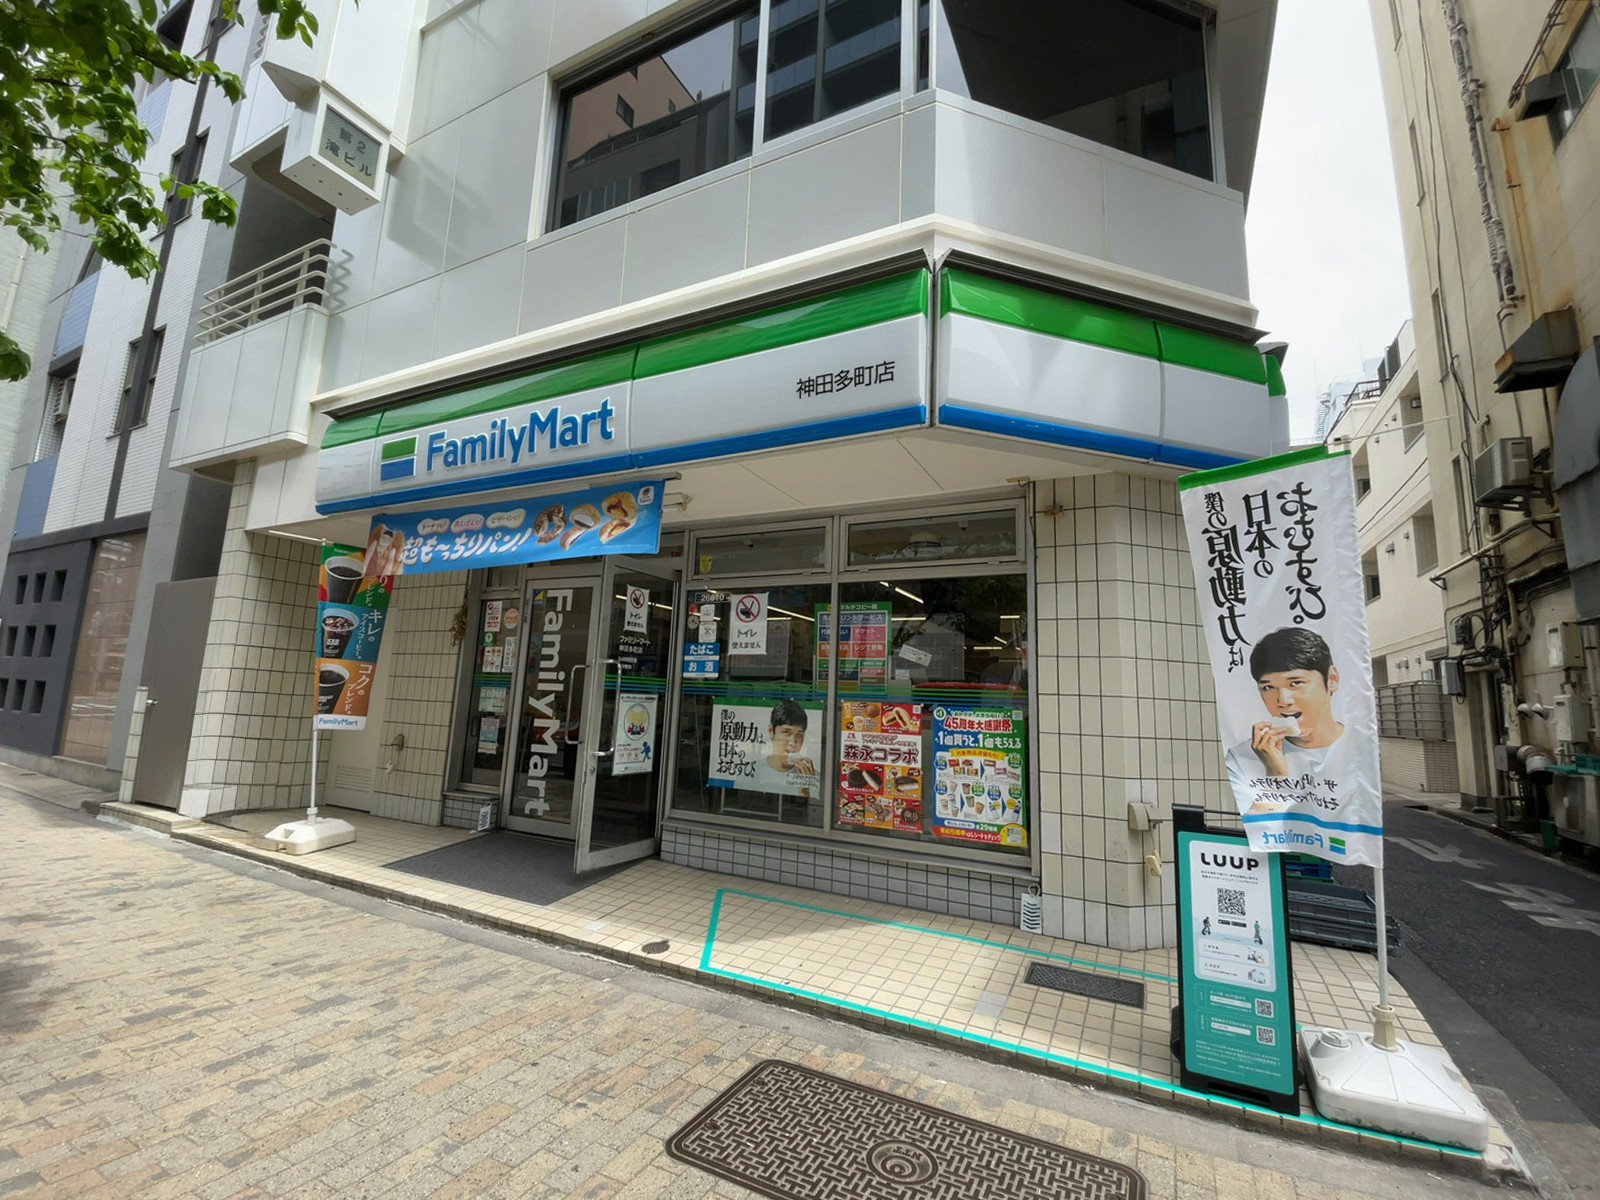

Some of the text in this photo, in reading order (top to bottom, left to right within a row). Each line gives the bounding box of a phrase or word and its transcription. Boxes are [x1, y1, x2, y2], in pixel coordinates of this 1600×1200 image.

[796, 361, 895, 399] 神田多町店
[426, 397, 615, 472] FamilyMart
[367, 609, 383, 643] キレの
[737, 629, 757, 638] トイレ
[620, 635, 651, 647] ファミリーマート
[689, 644, 714, 655] たばこ
[731, 641, 761, 649] 使えません
[688, 661, 714, 672] お酒
[356, 663, 373, 696] コクの
[524, 589, 573, 817] FamilyMart
[318, 718, 358, 726] FamilyMart
[720, 709, 735, 720] 僕の
[720, 721, 766, 745] 原動力は、
[943, 716, 1013, 732] 45周年大感謝祭
[938, 731, 1021, 749] 1個買うと、1個もらえる
[719, 741, 745, 759] 日本の
[843, 745, 919, 765] 森永コラボ
[716, 759, 757, 778] おむすび。
[1200, 852, 1259, 871] LUUP
[892, 1146, 922, 1161] NTT
